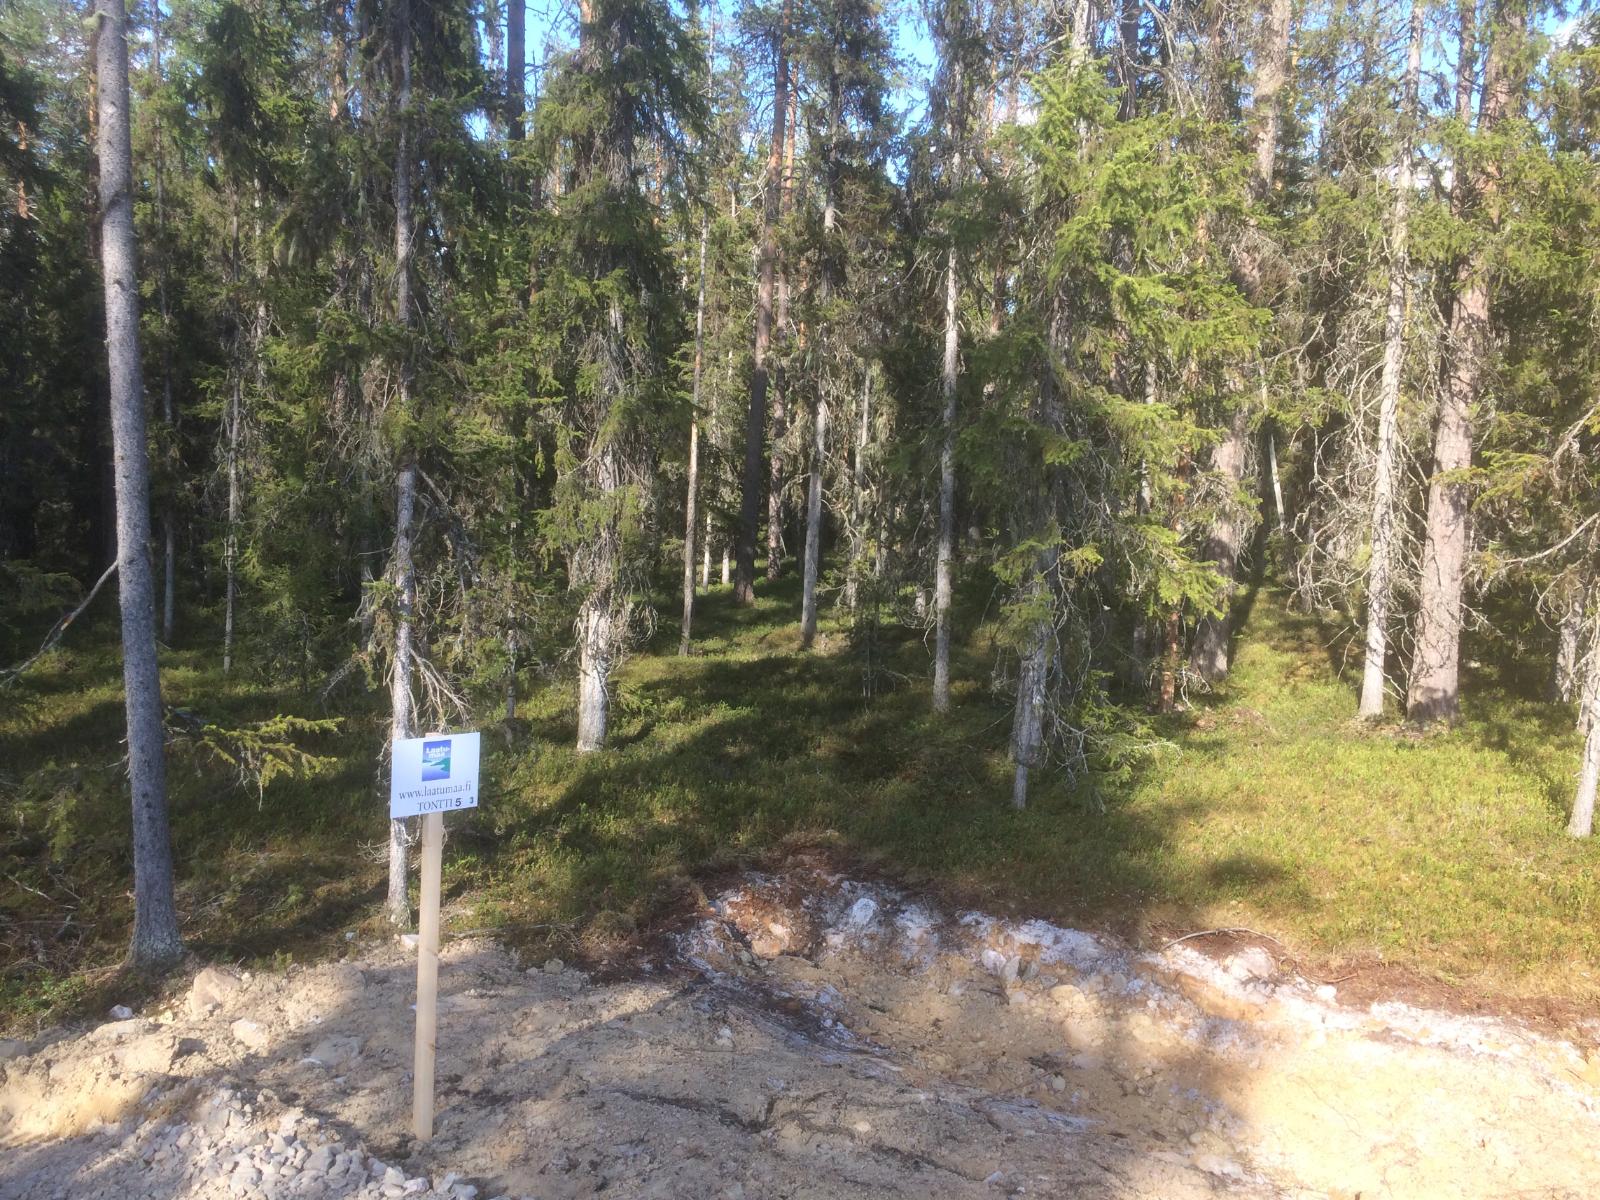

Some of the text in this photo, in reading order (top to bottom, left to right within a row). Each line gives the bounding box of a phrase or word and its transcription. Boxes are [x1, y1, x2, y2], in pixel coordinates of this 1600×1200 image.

[398, 781, 471, 800] www.laatumaa.fi
[417, 798, 453, 811] TONTTI
[455, 797, 463, 807] 5
